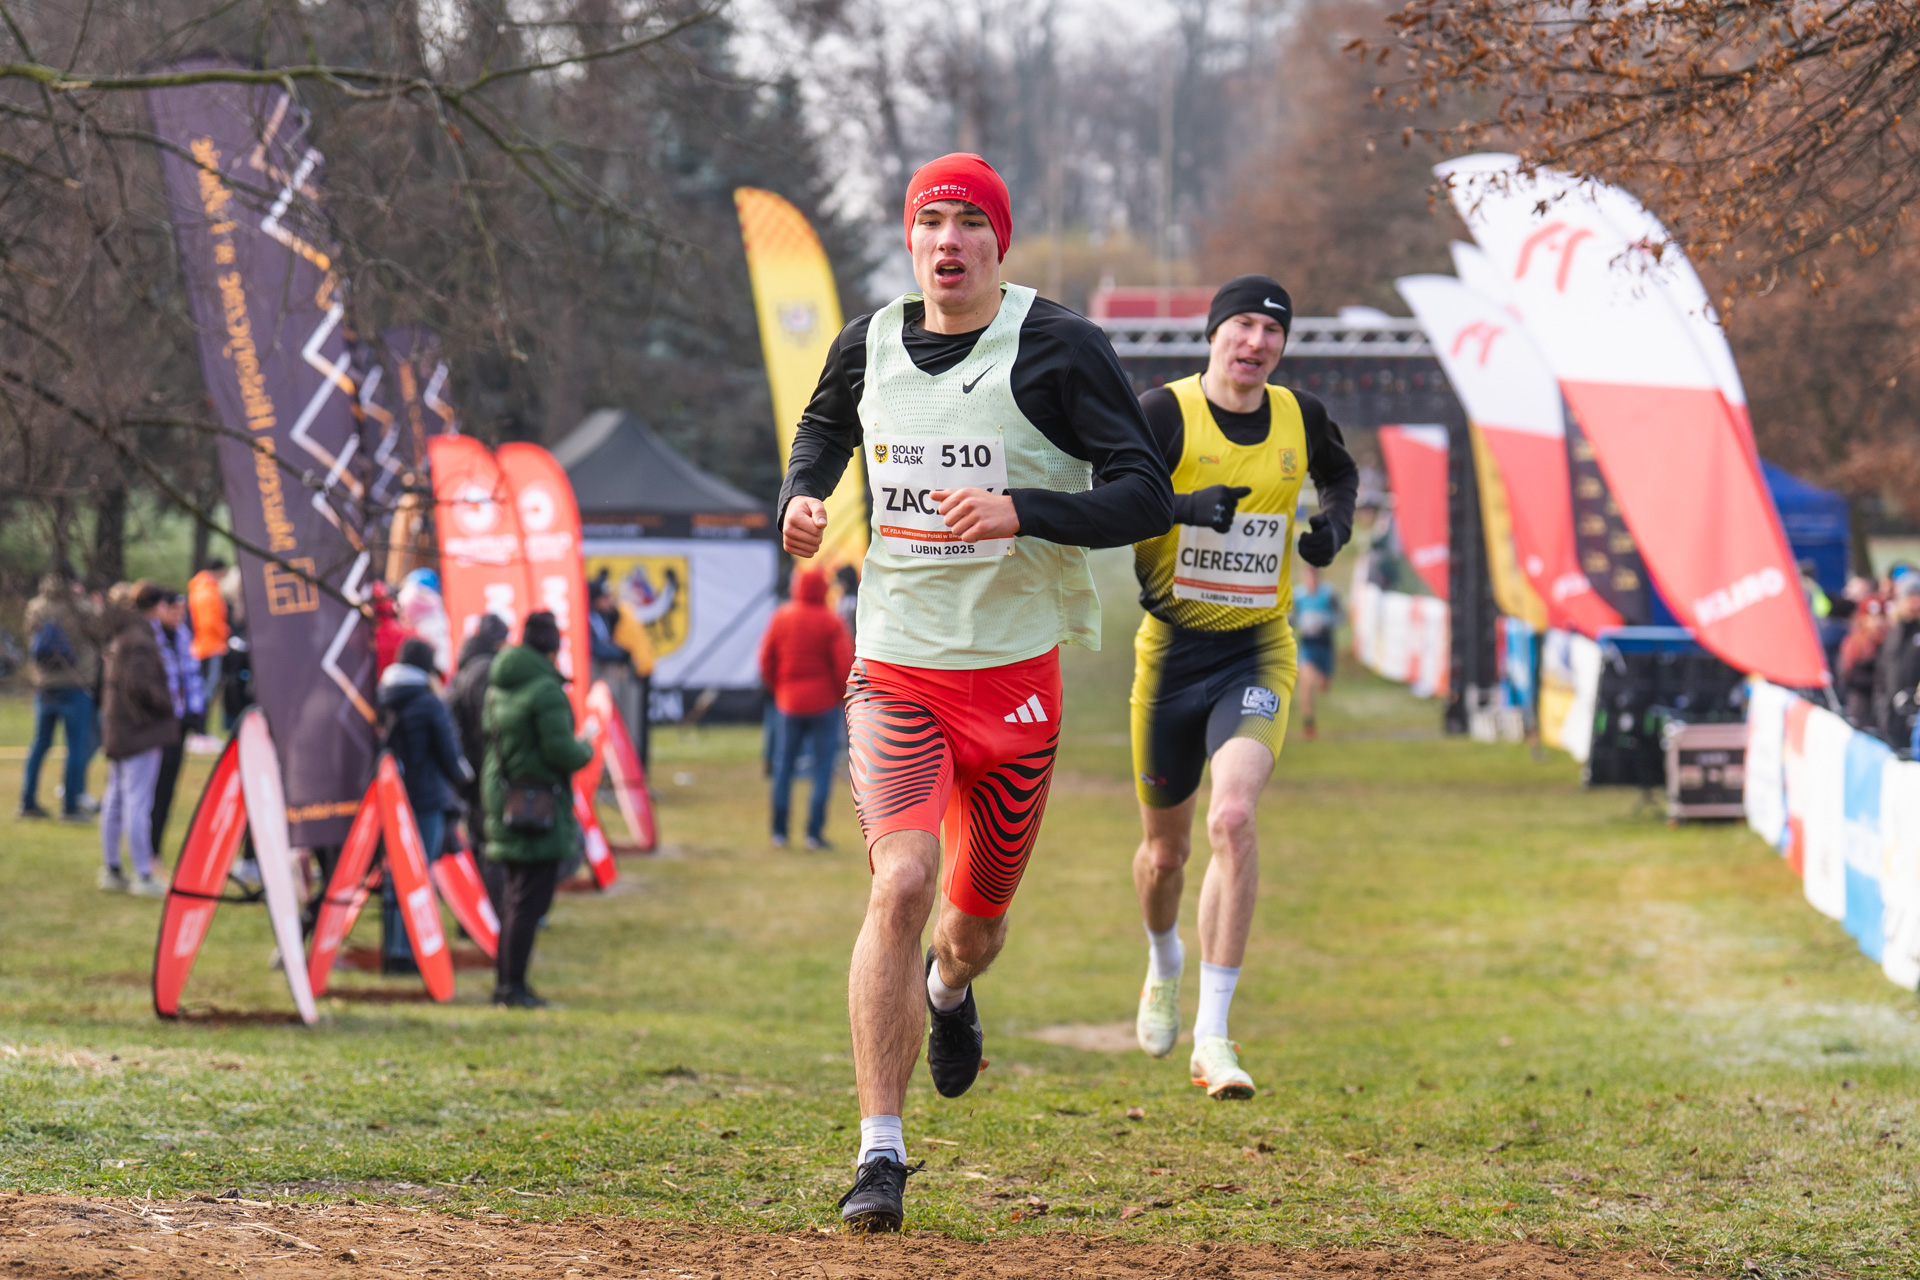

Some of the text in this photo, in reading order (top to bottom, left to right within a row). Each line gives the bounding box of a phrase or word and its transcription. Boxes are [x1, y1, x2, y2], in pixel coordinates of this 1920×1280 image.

[892, 444, 925, 455] DOLNY
[941, 444, 992, 468] 510
[892, 452, 924, 466] ŚLĄSK
[1242, 519, 1279, 538] 679
[910, 544, 975, 556] LUBIN 2025
[1180, 546, 1278, 574] CIERESZKO
[1200, 591, 1229, 602] LUBIN
